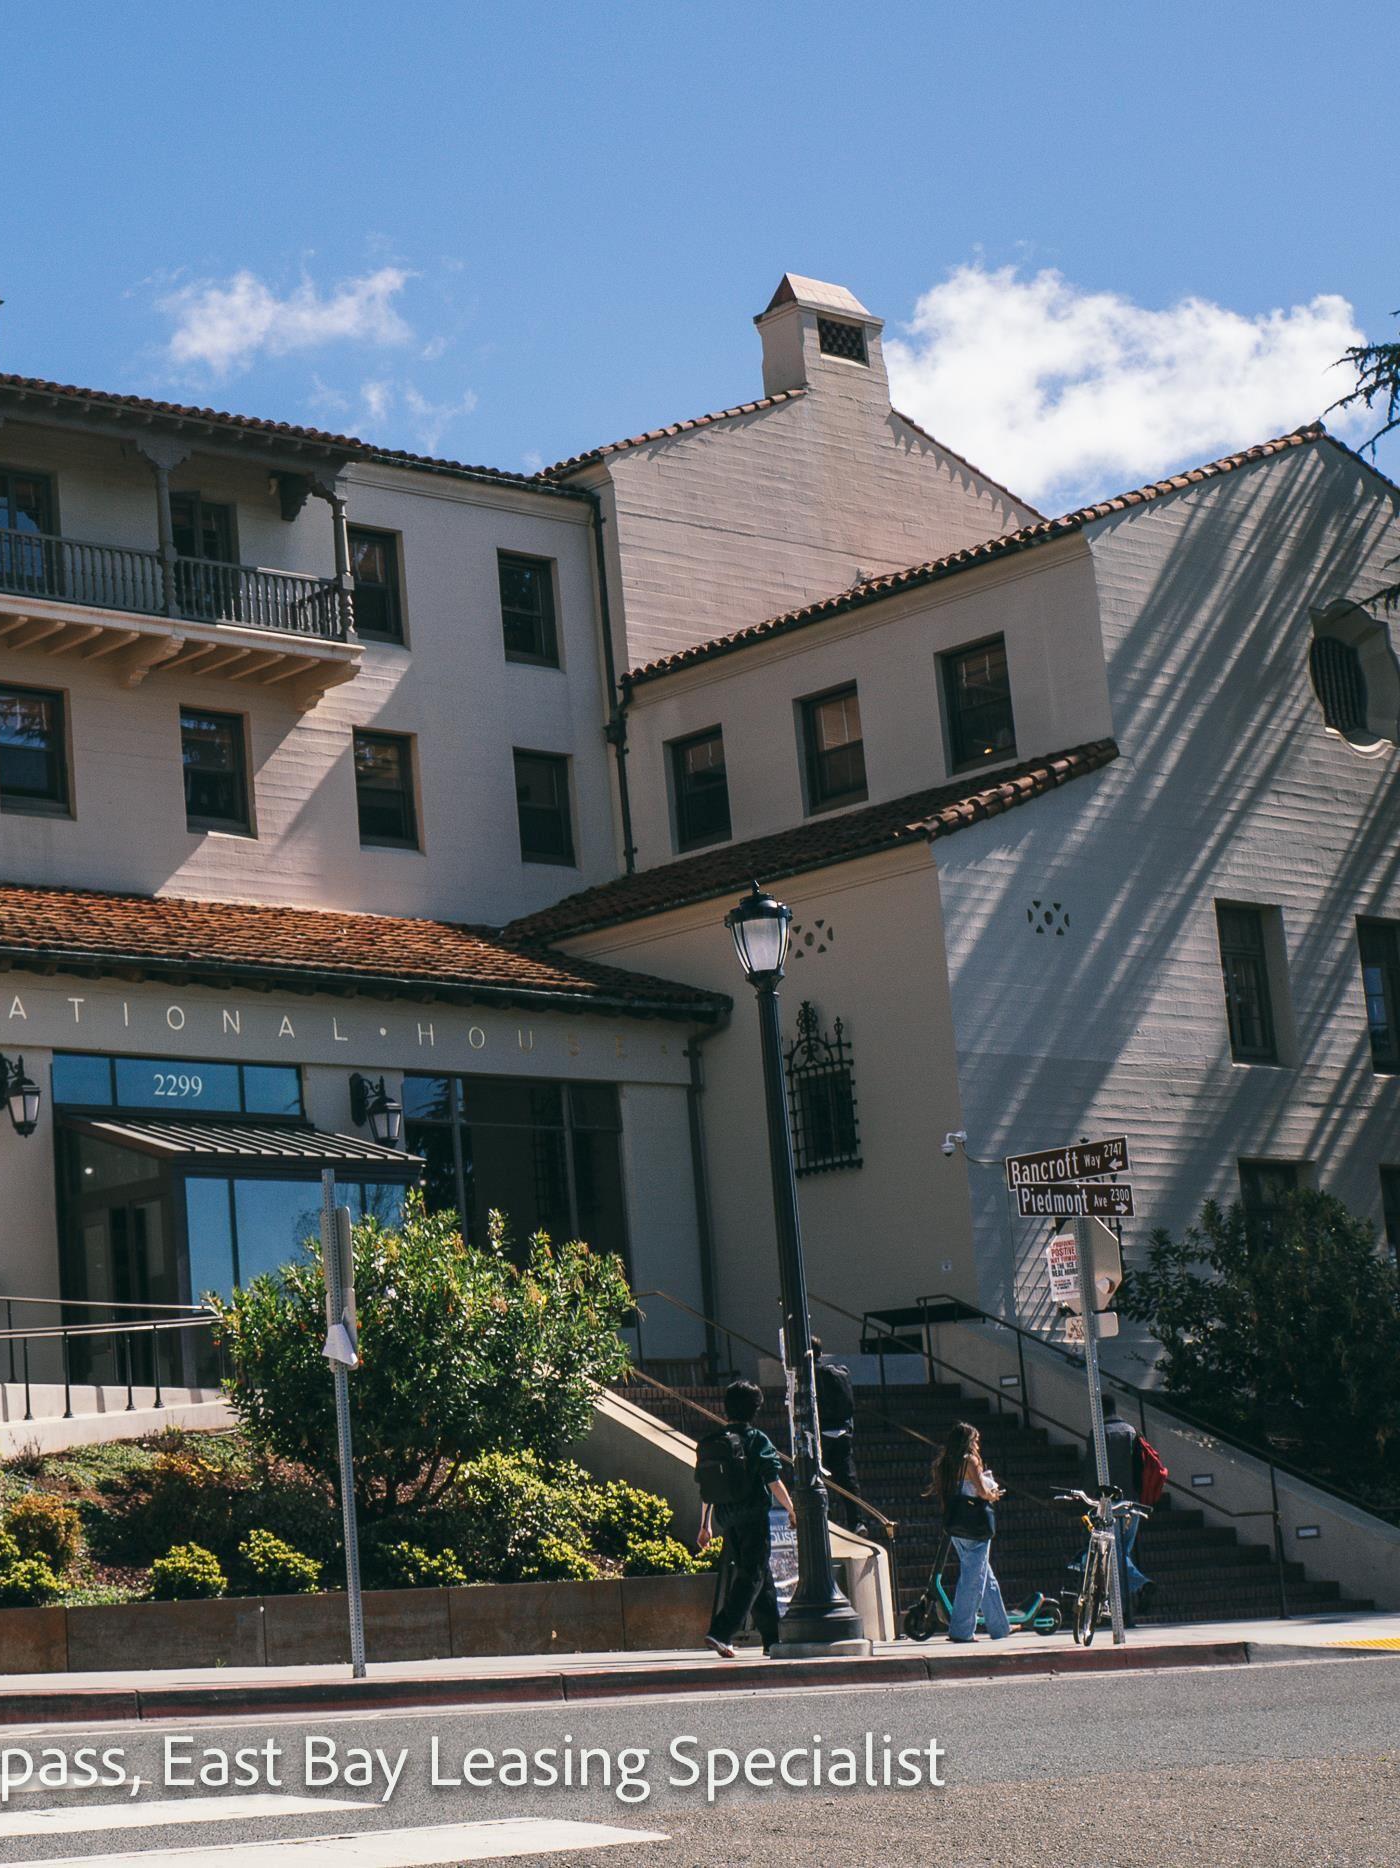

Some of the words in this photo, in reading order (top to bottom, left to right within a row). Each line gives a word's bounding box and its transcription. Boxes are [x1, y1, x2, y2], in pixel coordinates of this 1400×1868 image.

[153, 1073, 203, 1098] 2299
[1011, 1151, 1080, 1185] Bancroft
[1084, 1153, 1101, 1169] Way
[1104, 1142, 1123, 1158] 2747
[1021, 1187, 1089, 1214] Piedmont
[1093, 1194, 1108, 1208] Ave
[1110, 1188, 1130, 1202] 2300
